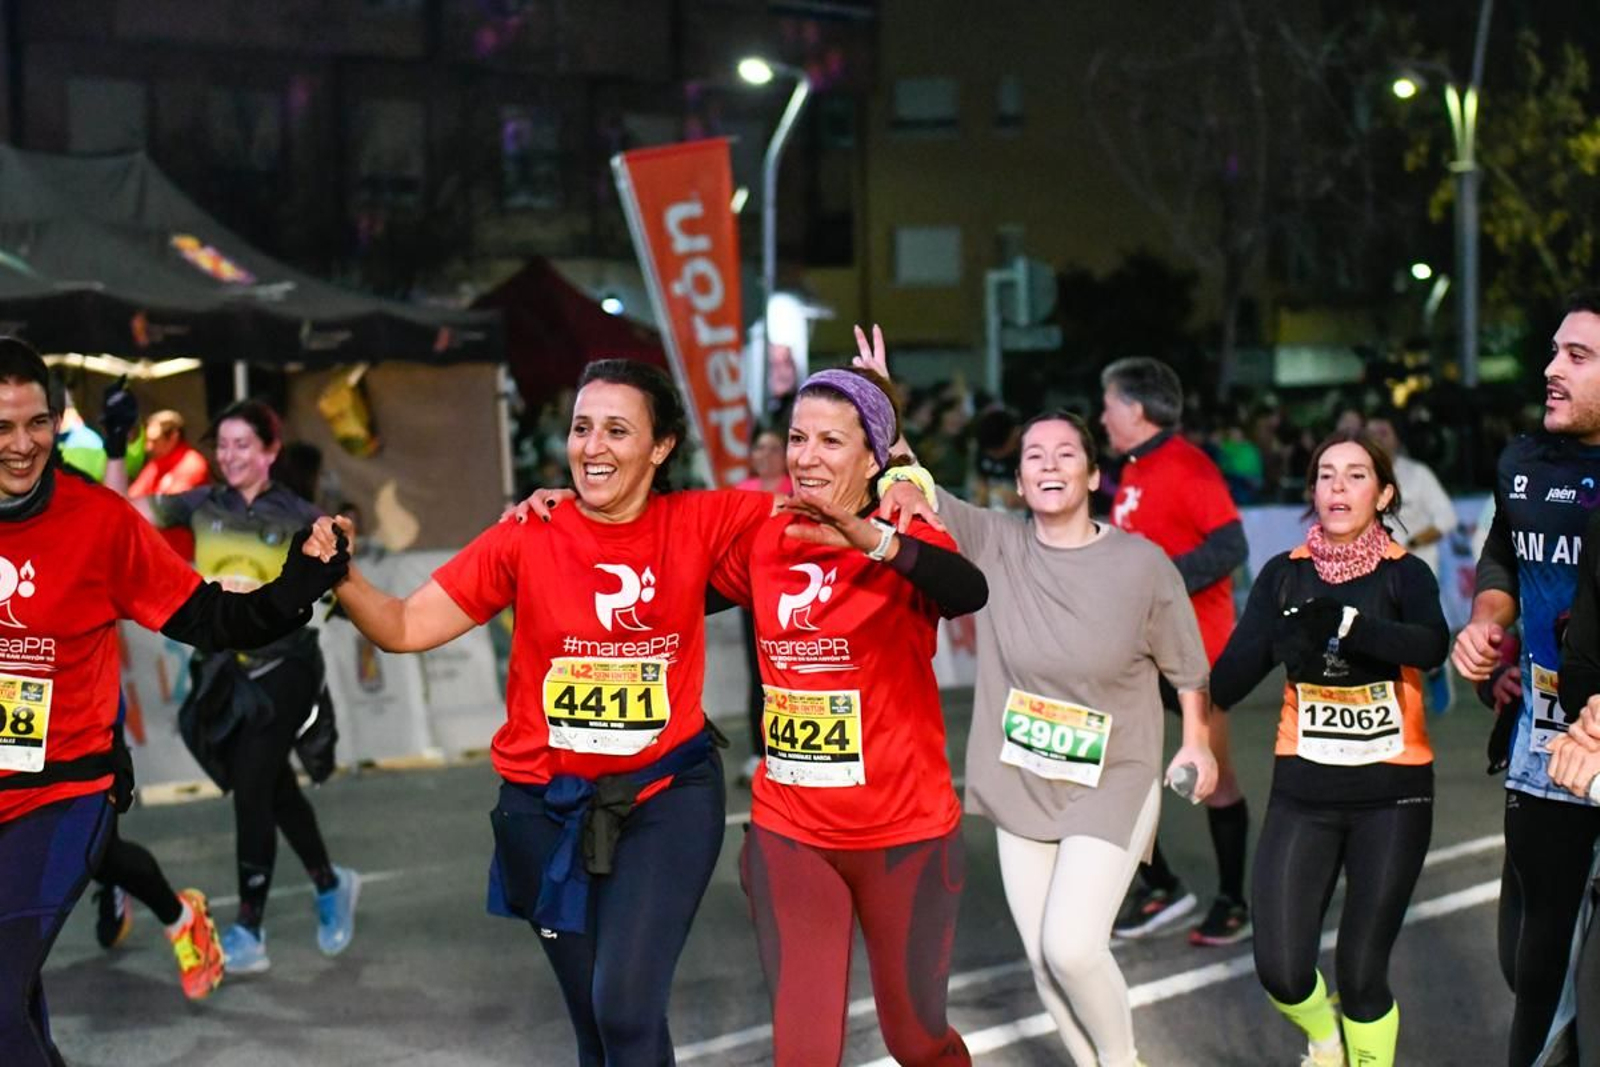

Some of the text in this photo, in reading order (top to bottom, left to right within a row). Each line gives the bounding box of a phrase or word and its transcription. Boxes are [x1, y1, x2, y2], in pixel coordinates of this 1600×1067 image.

[1544, 485, 1577, 502] jaén
[563, 633, 680, 657] #mareaPR
[571, 664, 593, 679] 42
[554, 685, 654, 719] 4411
[0, 703, 36, 736] 8
[1304, 704, 1394, 730] 12062
[769, 715, 850, 751] 4424
[1010, 713, 1099, 758] 2907
